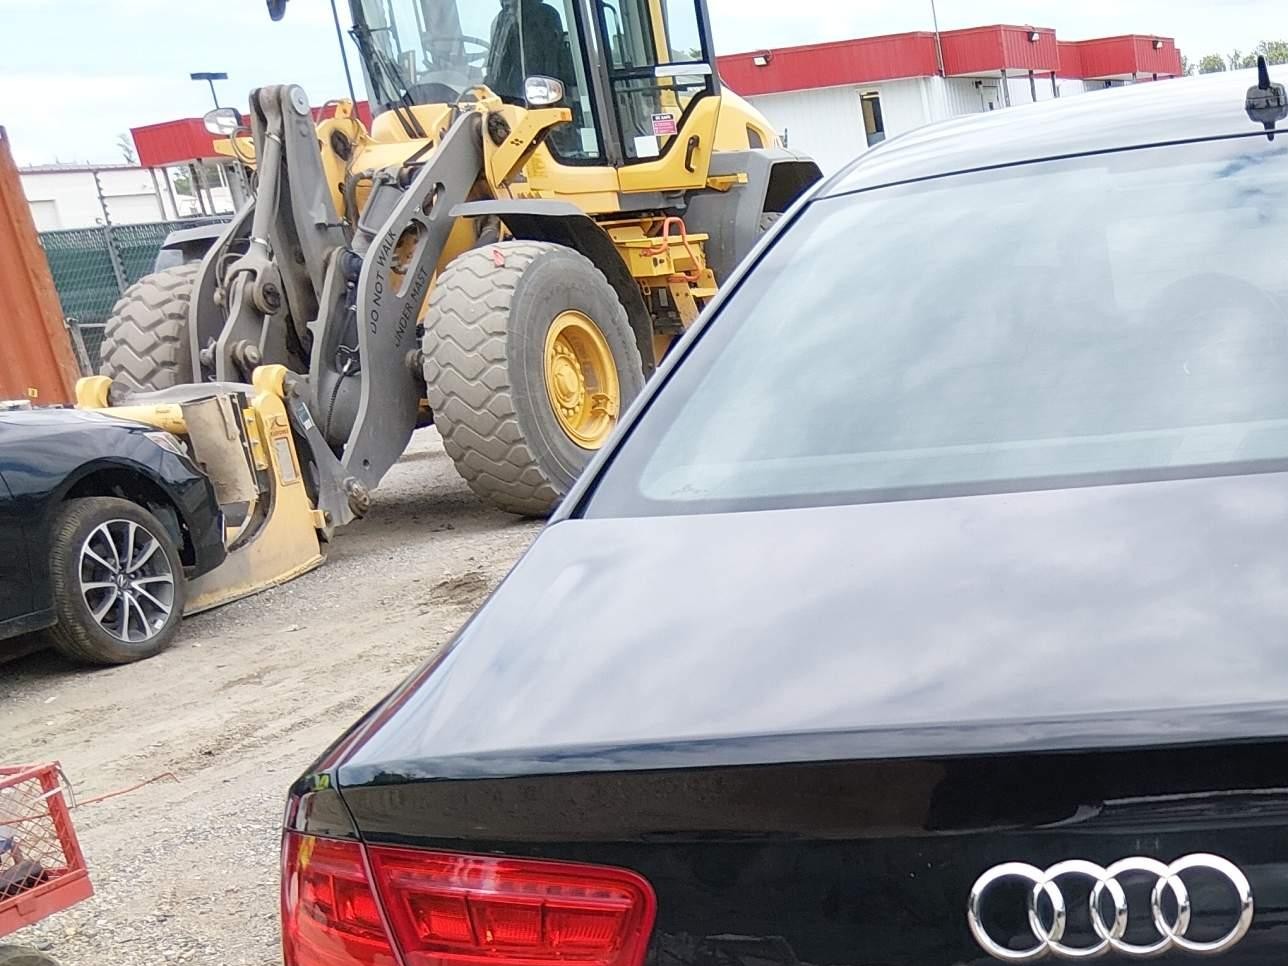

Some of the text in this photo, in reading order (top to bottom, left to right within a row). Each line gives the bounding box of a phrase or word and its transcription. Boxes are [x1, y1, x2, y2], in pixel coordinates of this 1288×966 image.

[370, 229, 396, 335] DO NOT WALK
[392, 267, 428, 348] UNDER MAST
